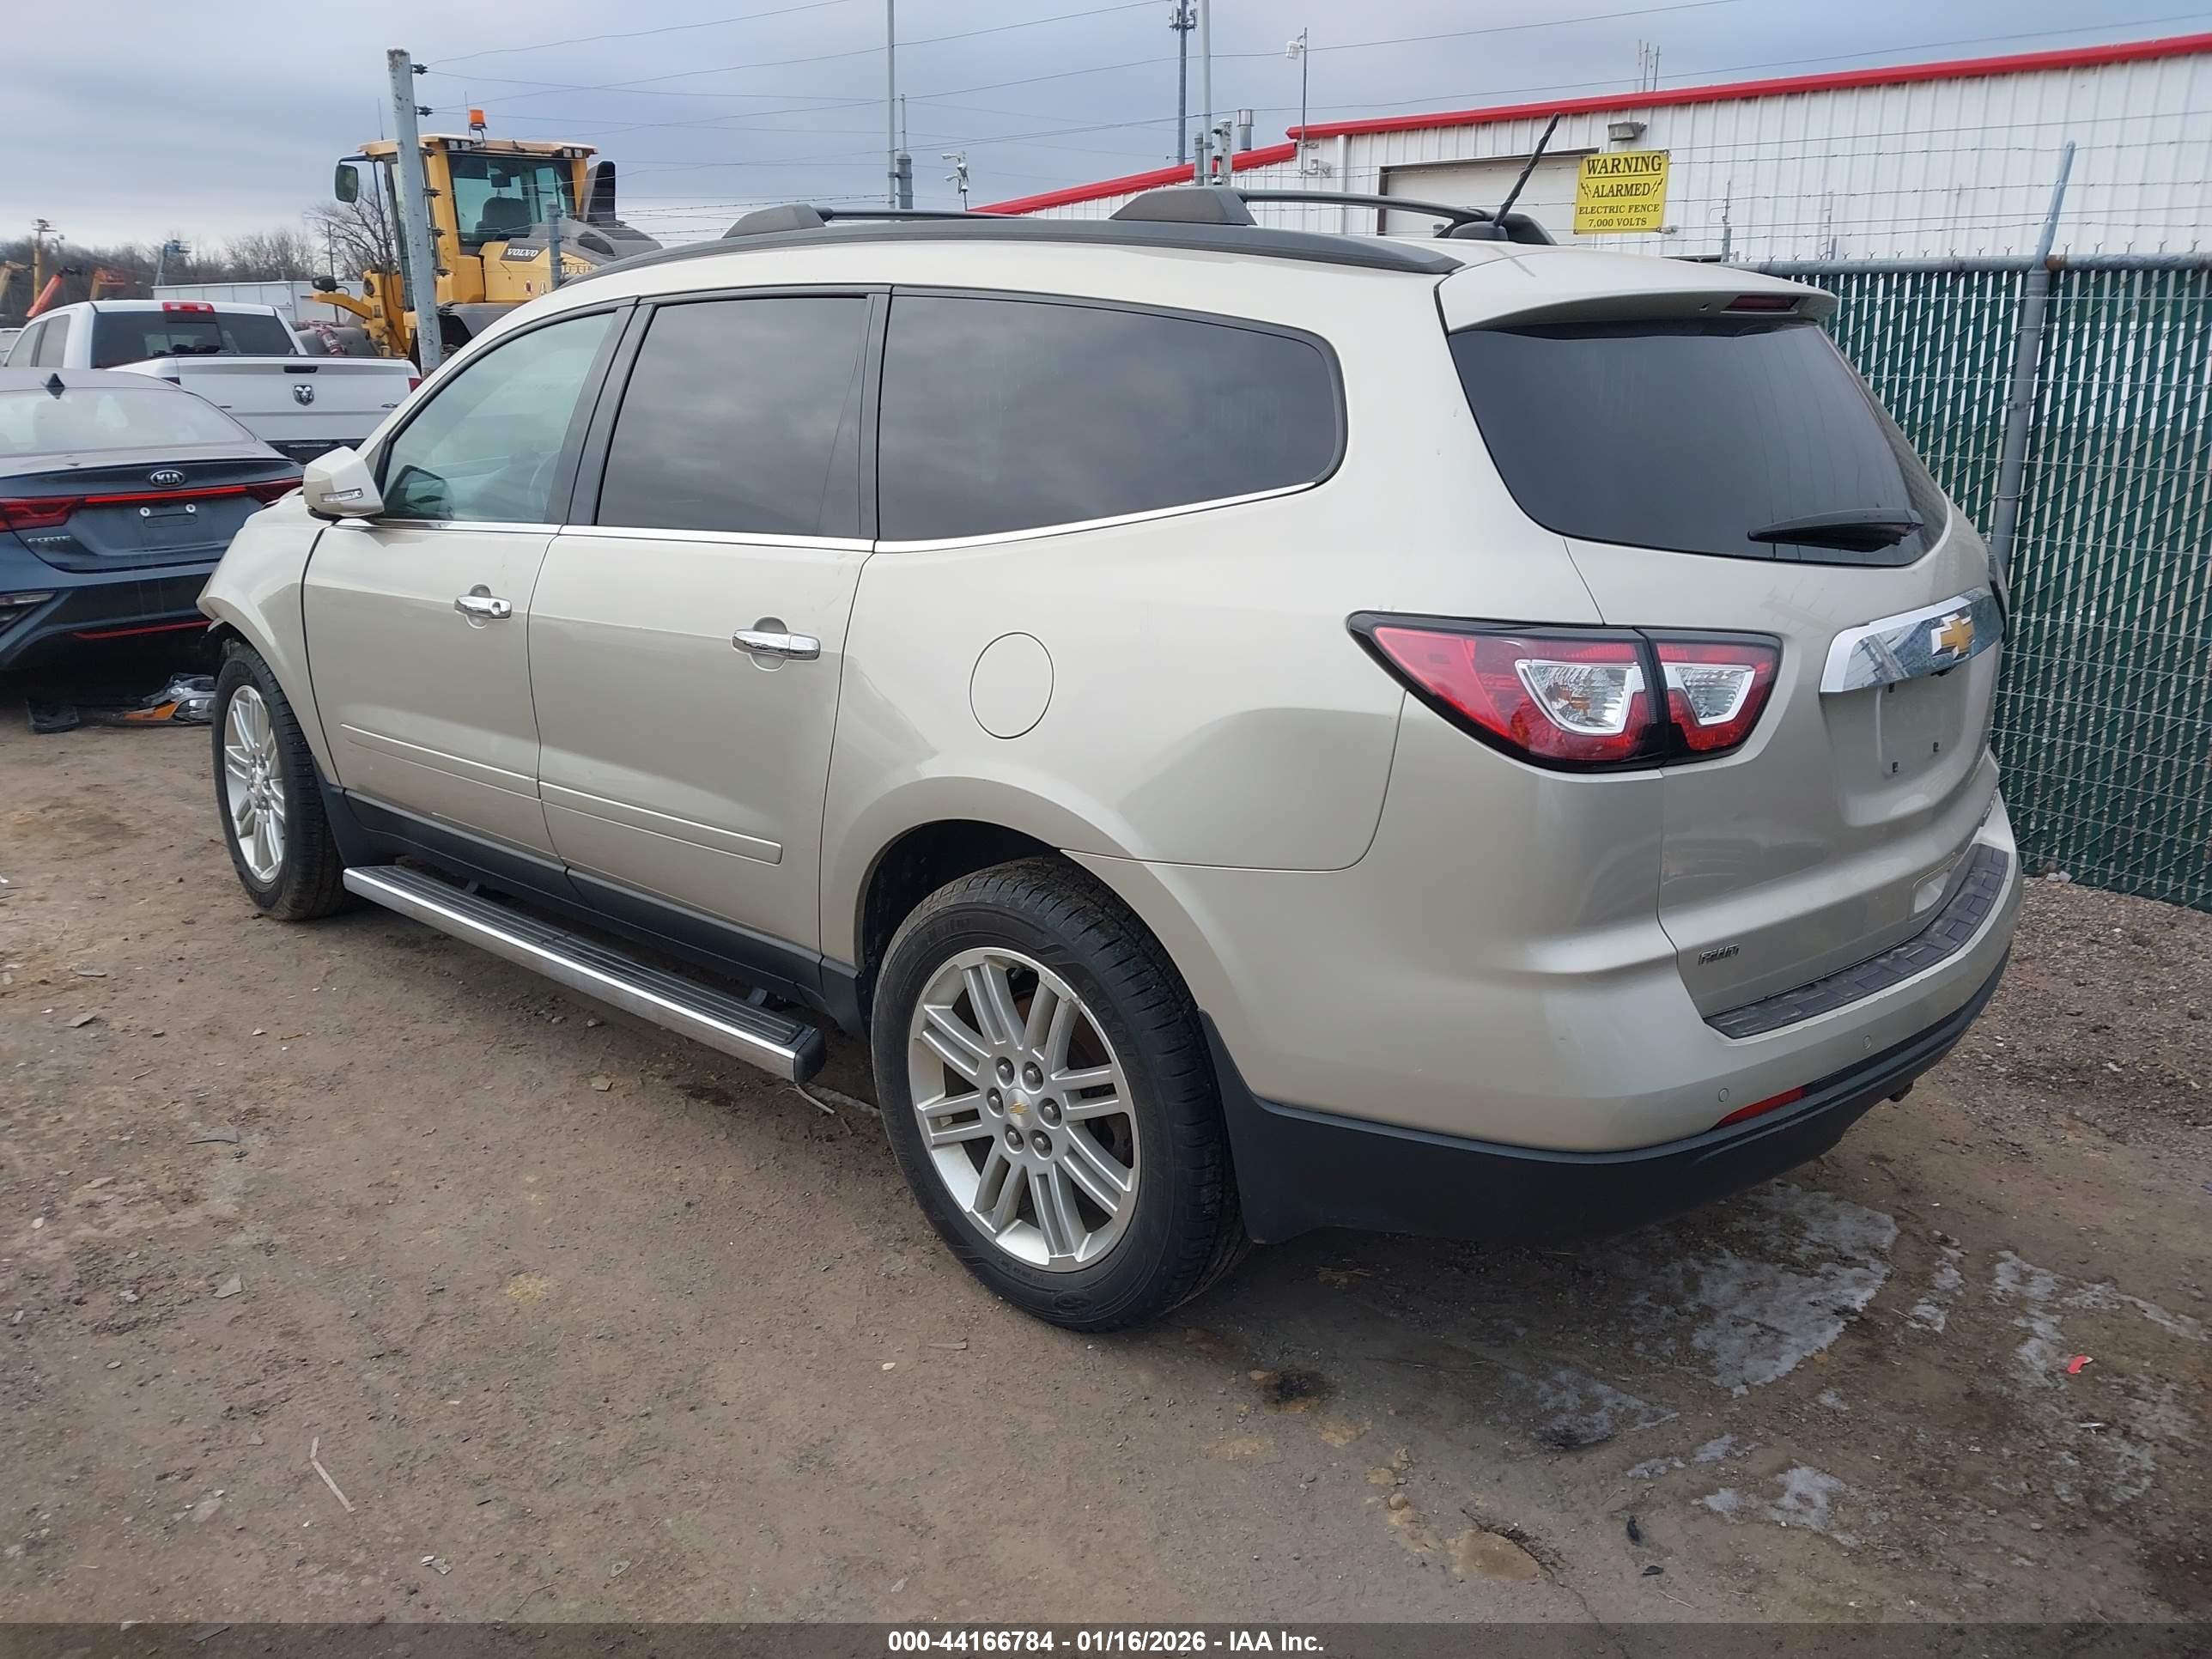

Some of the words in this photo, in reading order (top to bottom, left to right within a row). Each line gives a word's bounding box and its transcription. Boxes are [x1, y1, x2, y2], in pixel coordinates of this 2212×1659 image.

[1586, 155, 1662, 175] WARNING
[1591, 182, 1650, 198] ALARMED
[1578, 204, 1626, 215] ELECTRIC
[1627, 204, 1660, 214] FENCE
[1589, 218, 1613, 228] 7,000
[1616, 217, 1647, 227] VOLTS
[507, 248, 539, 257] VOLVO
